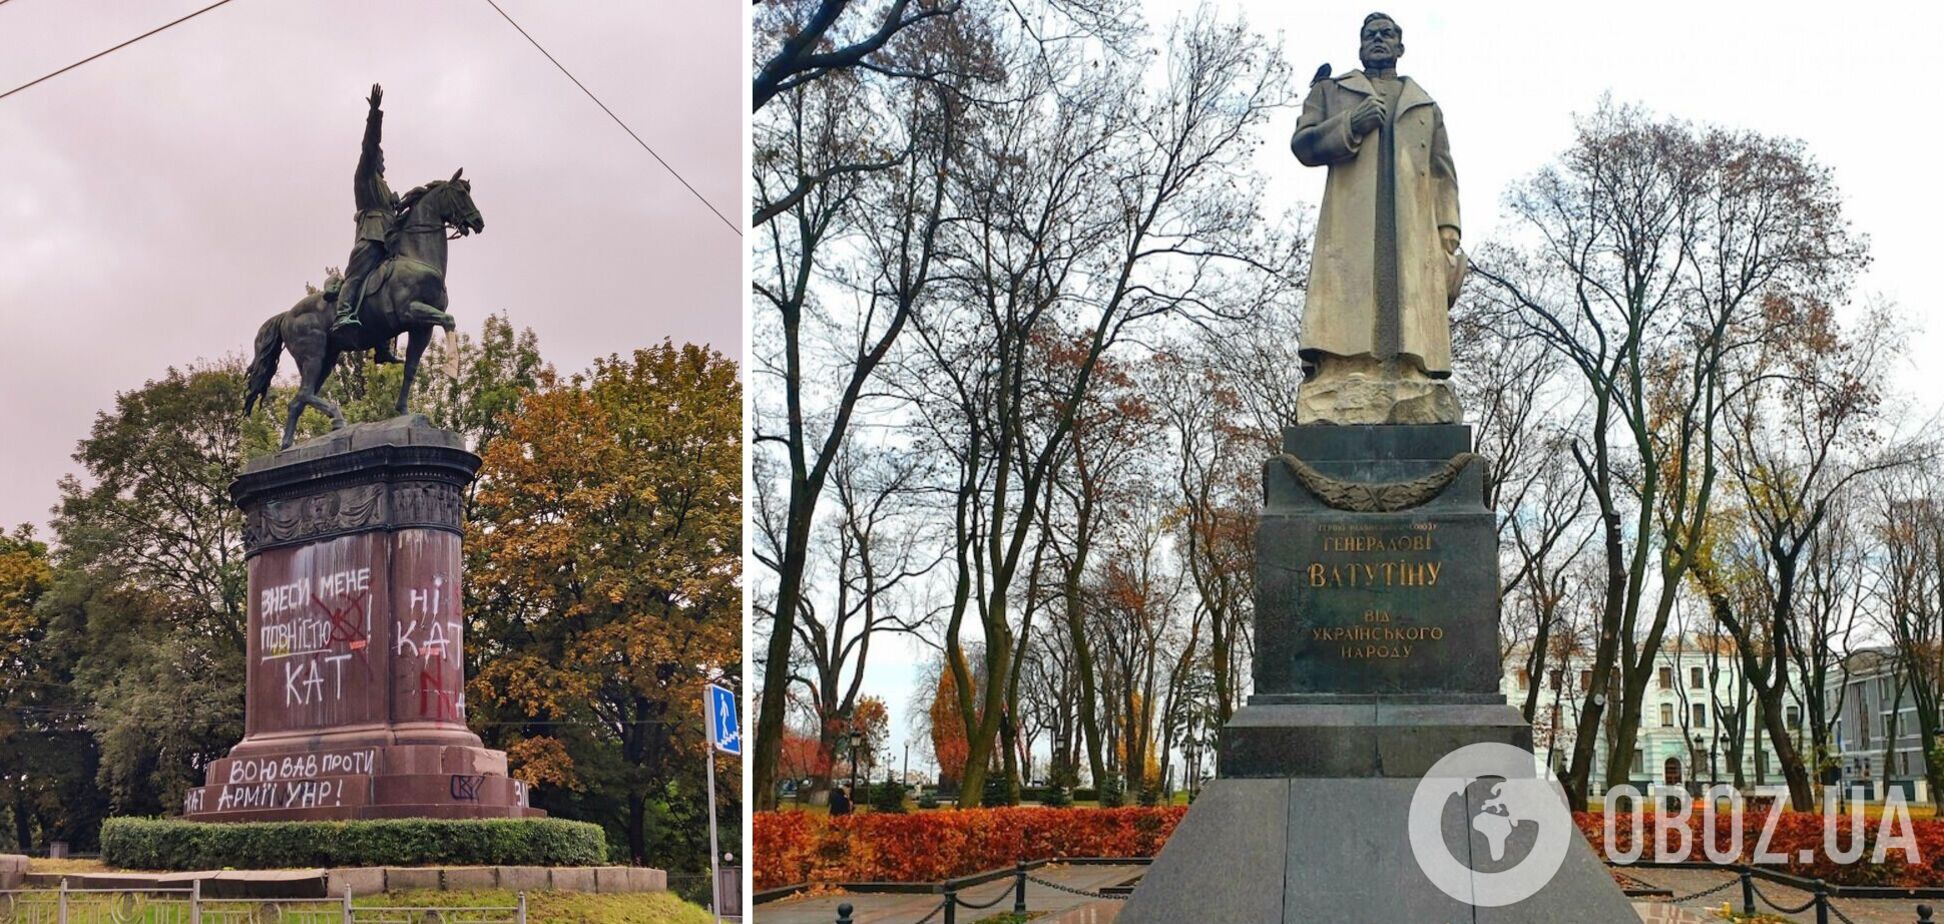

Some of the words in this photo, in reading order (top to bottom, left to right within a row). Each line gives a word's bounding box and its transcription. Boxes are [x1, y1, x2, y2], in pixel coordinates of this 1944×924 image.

[1323, 535, 1433, 552] ГЕНЕРАЛОВІ
[320, 568, 370, 600] МЕНЕ
[1307, 560, 1442, 588] ВАТУТІНУ
[1364, 608, 1393, 623] ВІД
[261, 616, 331, 651] ПОВНІСТЮ
[396, 620, 463, 669] КАТ
[1312, 625, 1444, 641] УКРАЇНСЬКОГО
[1341, 645, 1413, 659] НАРОДУ
[286, 654, 352, 707] КАТ
[322, 750, 375, 774] ПРОТИ
